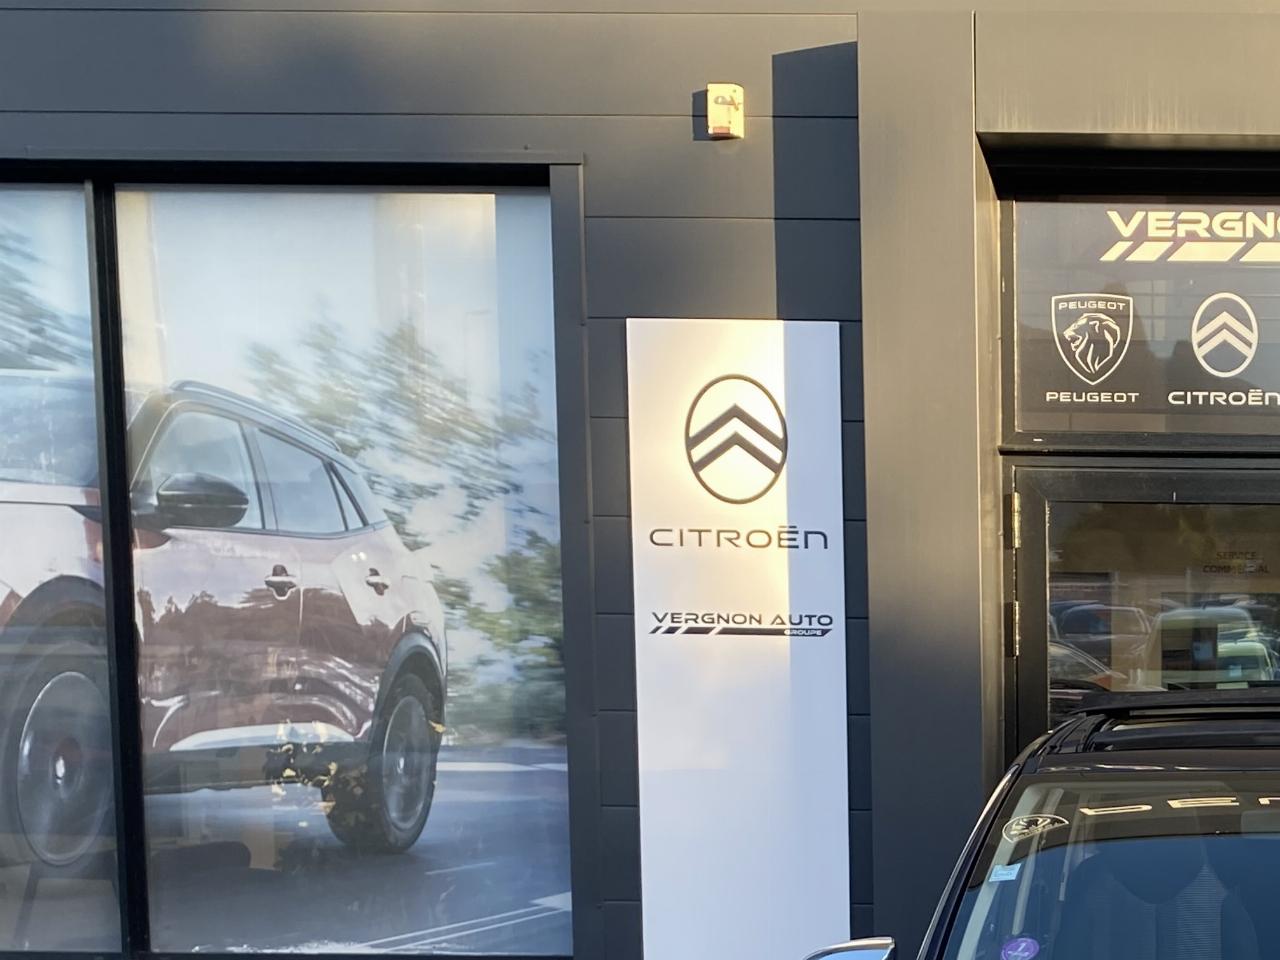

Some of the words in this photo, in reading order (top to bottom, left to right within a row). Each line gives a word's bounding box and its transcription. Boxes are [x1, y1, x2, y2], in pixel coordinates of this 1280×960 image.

[1058, 299, 1127, 313] PEUGEOT
[1045, 390, 1140, 403] PEUGEOT
[652, 612, 763, 625] VERGNON
[770, 613, 833, 626] AUTO
